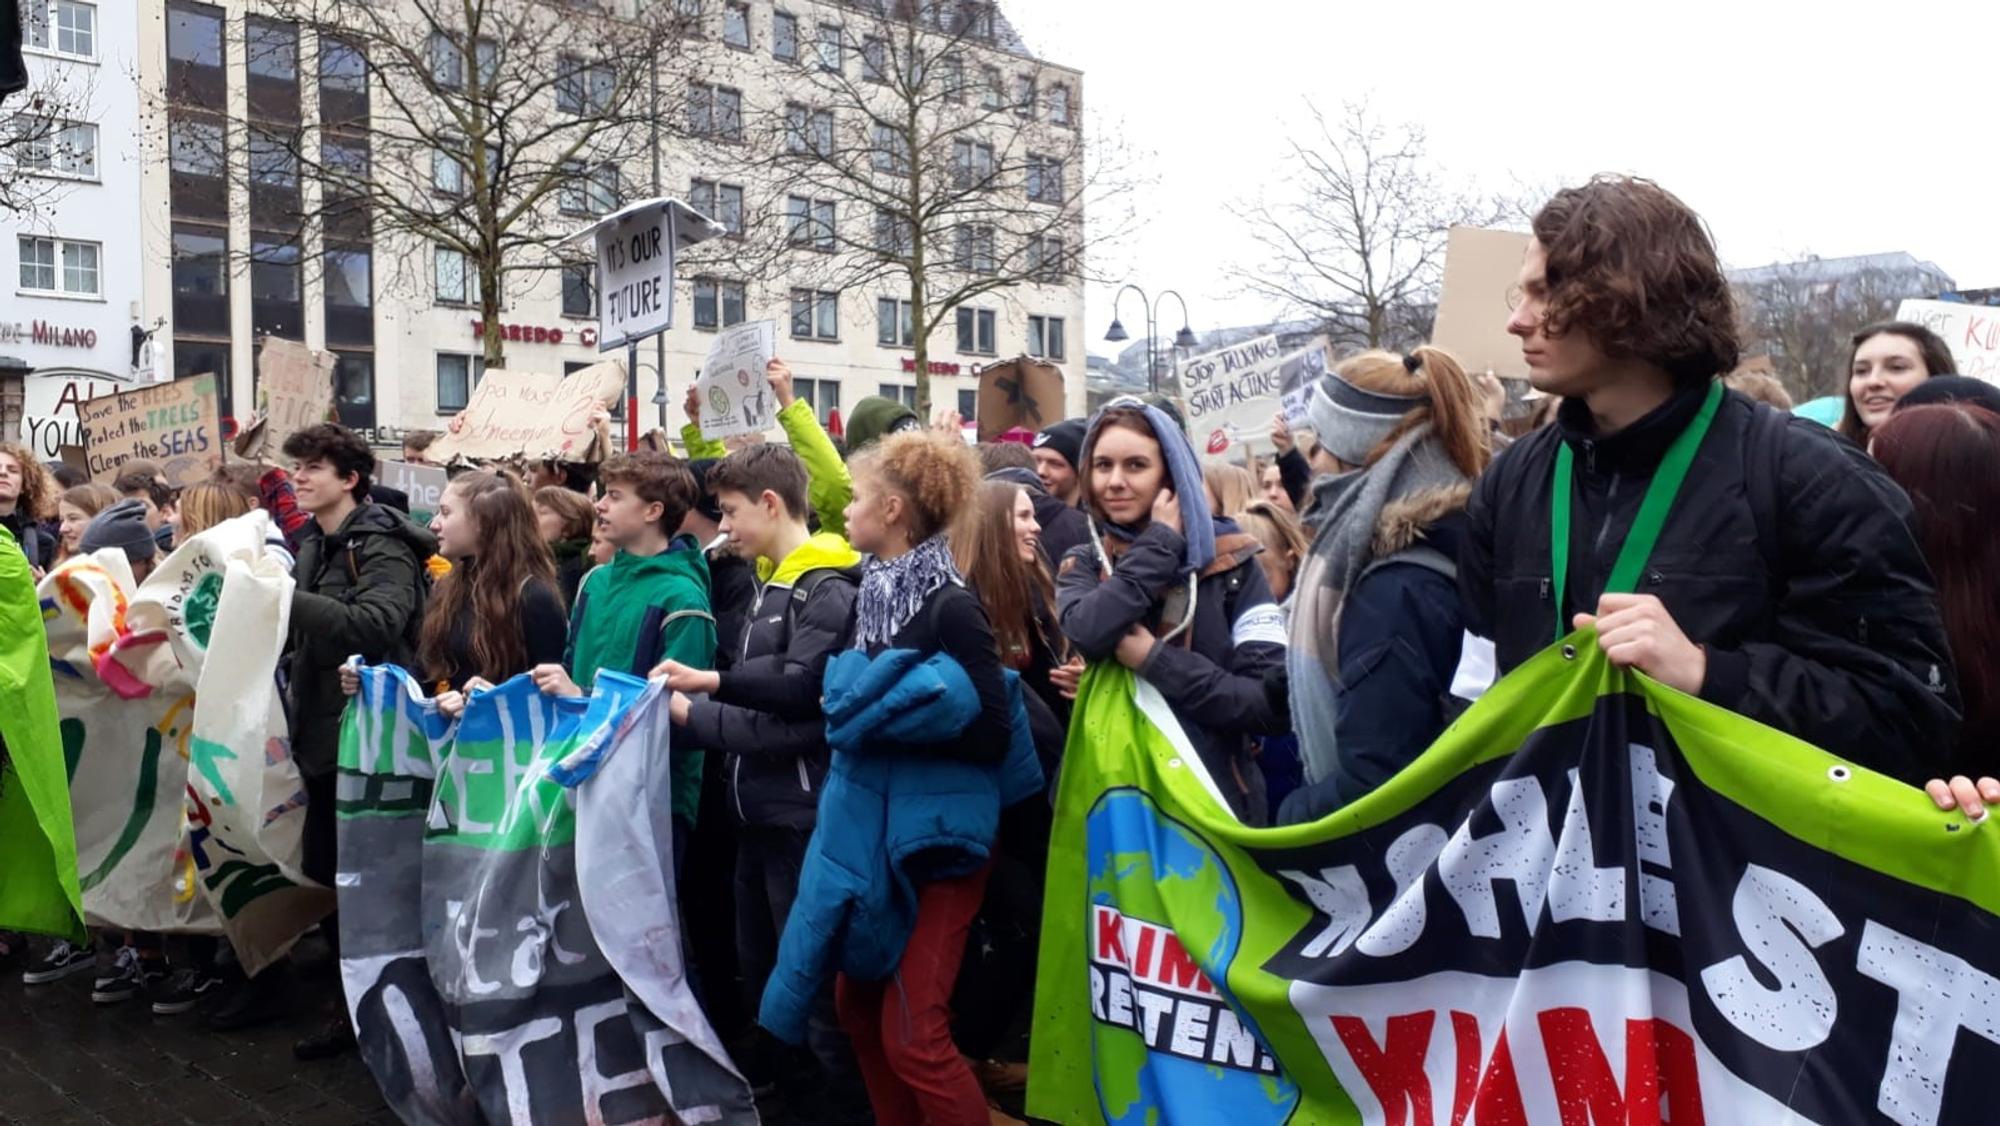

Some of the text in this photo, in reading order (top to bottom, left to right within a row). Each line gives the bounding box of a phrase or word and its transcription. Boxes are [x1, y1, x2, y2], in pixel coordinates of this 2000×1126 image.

[606, 226, 662, 274] IT'S OUR
[609, 275, 661, 326] FUTURE
[1185, 359, 1216, 388] STOP
[1217, 339, 1278, 373] TALKING
[83, 385, 182, 423] Save the BEES
[1190, 383, 1225, 418] START
[1229, 366, 1281, 406] ACTING
[83, 400, 199, 451] Protect the TREES
[89, 426, 208, 475] Clean the SEAS
[398, 468, 440, 505] the
[1099, 909, 1214, 994] KIM
